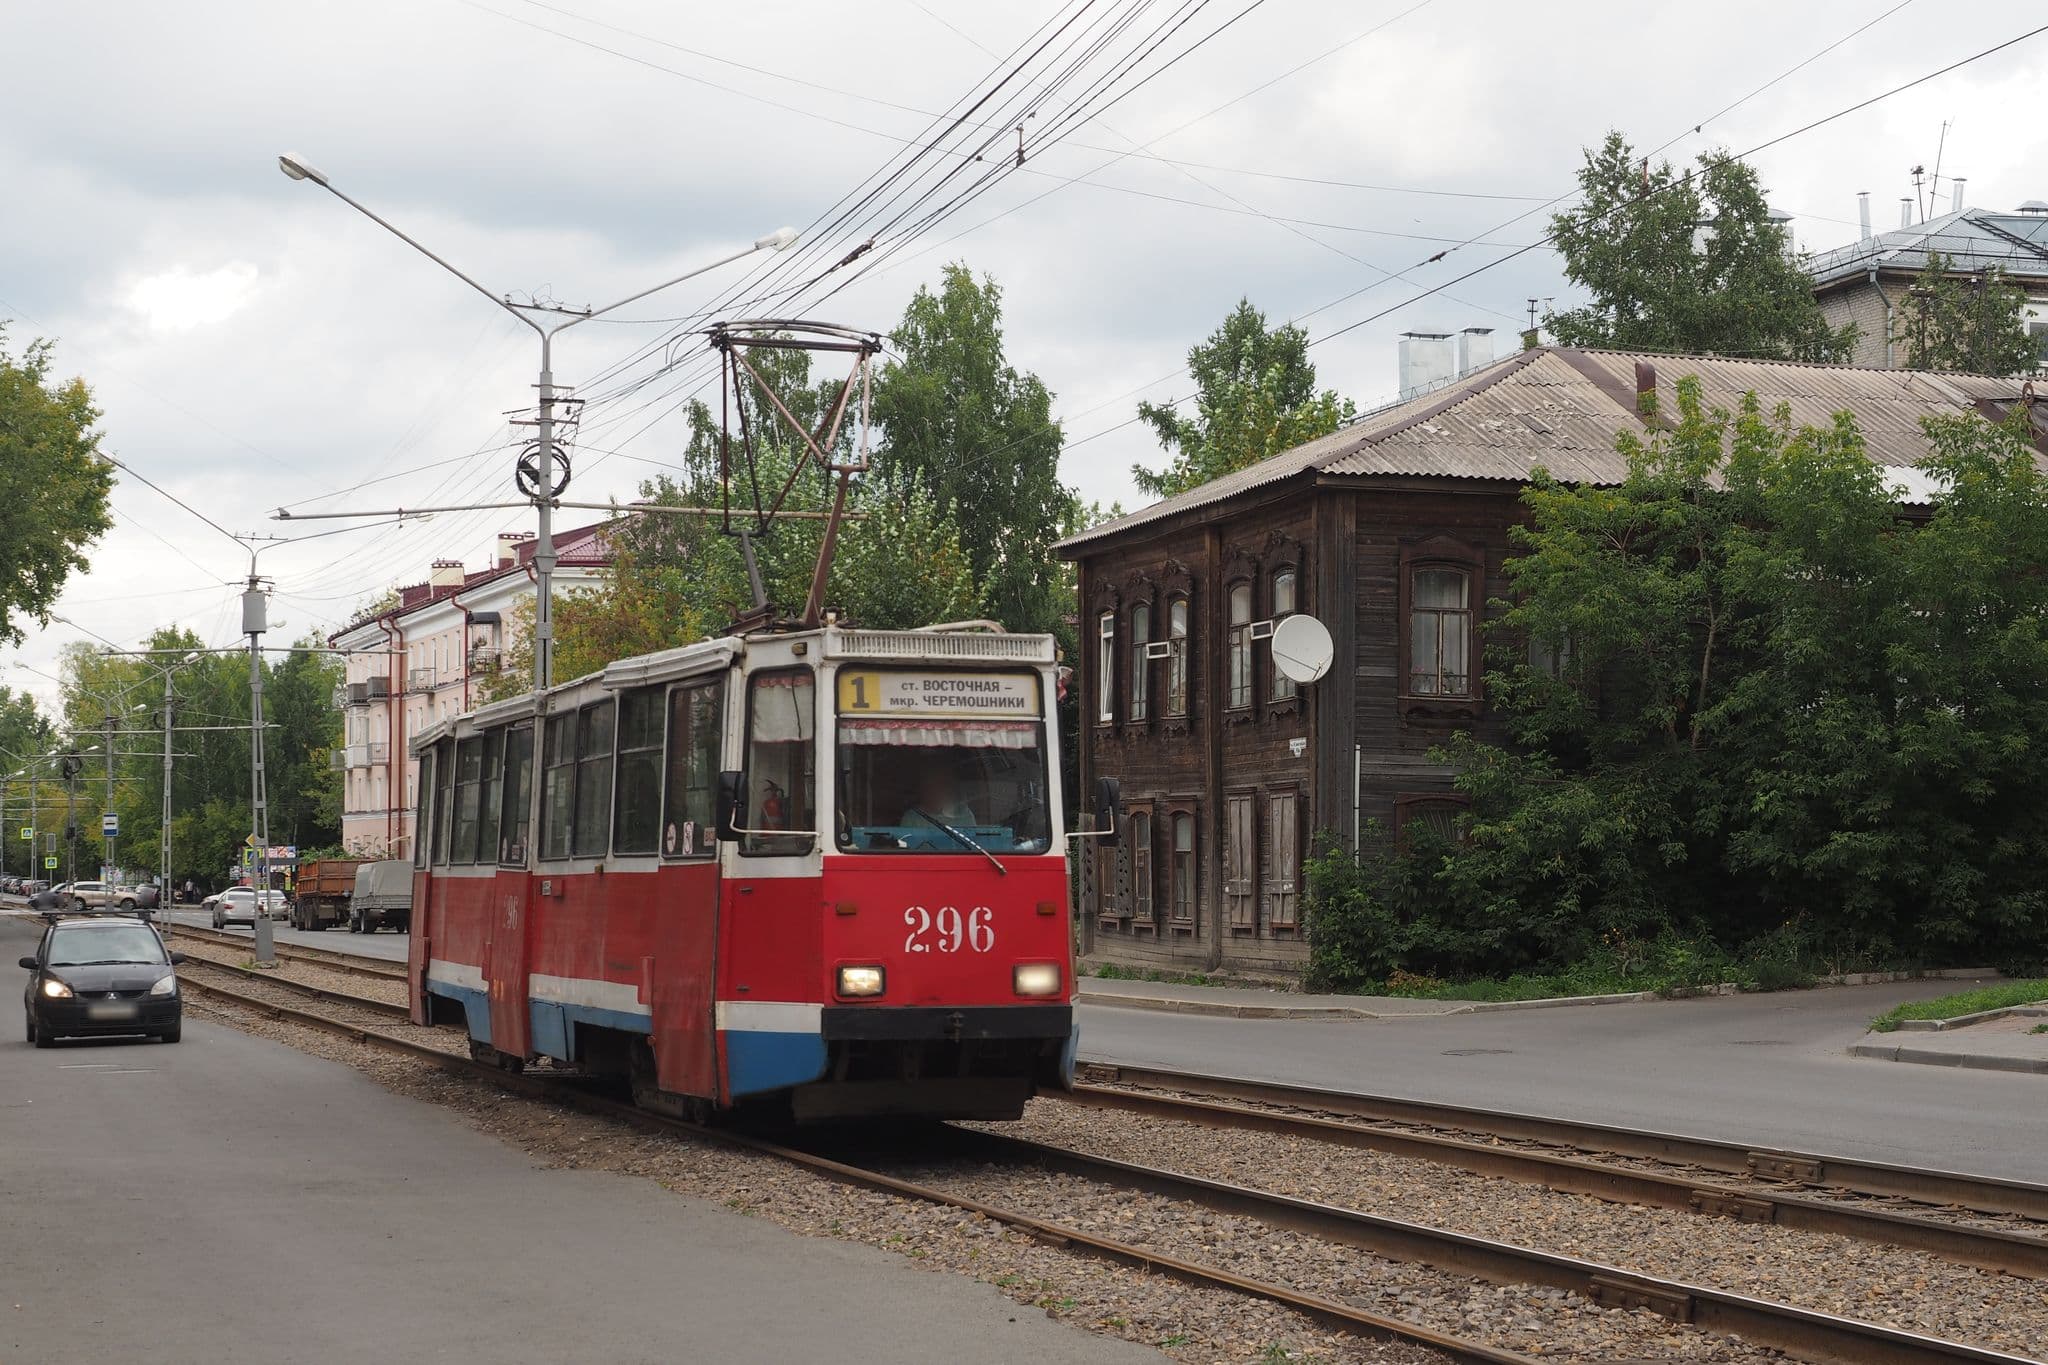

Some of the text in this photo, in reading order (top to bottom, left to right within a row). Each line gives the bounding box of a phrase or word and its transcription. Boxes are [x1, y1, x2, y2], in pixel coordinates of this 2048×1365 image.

[851, 676, 869, 708] 1
[901, 682, 918, 691] ст.
[923, 680, 999, 692] ВОСТОЧНАЯ
[889, 696, 1024, 708] мкр. ЧЕРЕМОШНИКИ
[904, 906, 994, 952] 296
